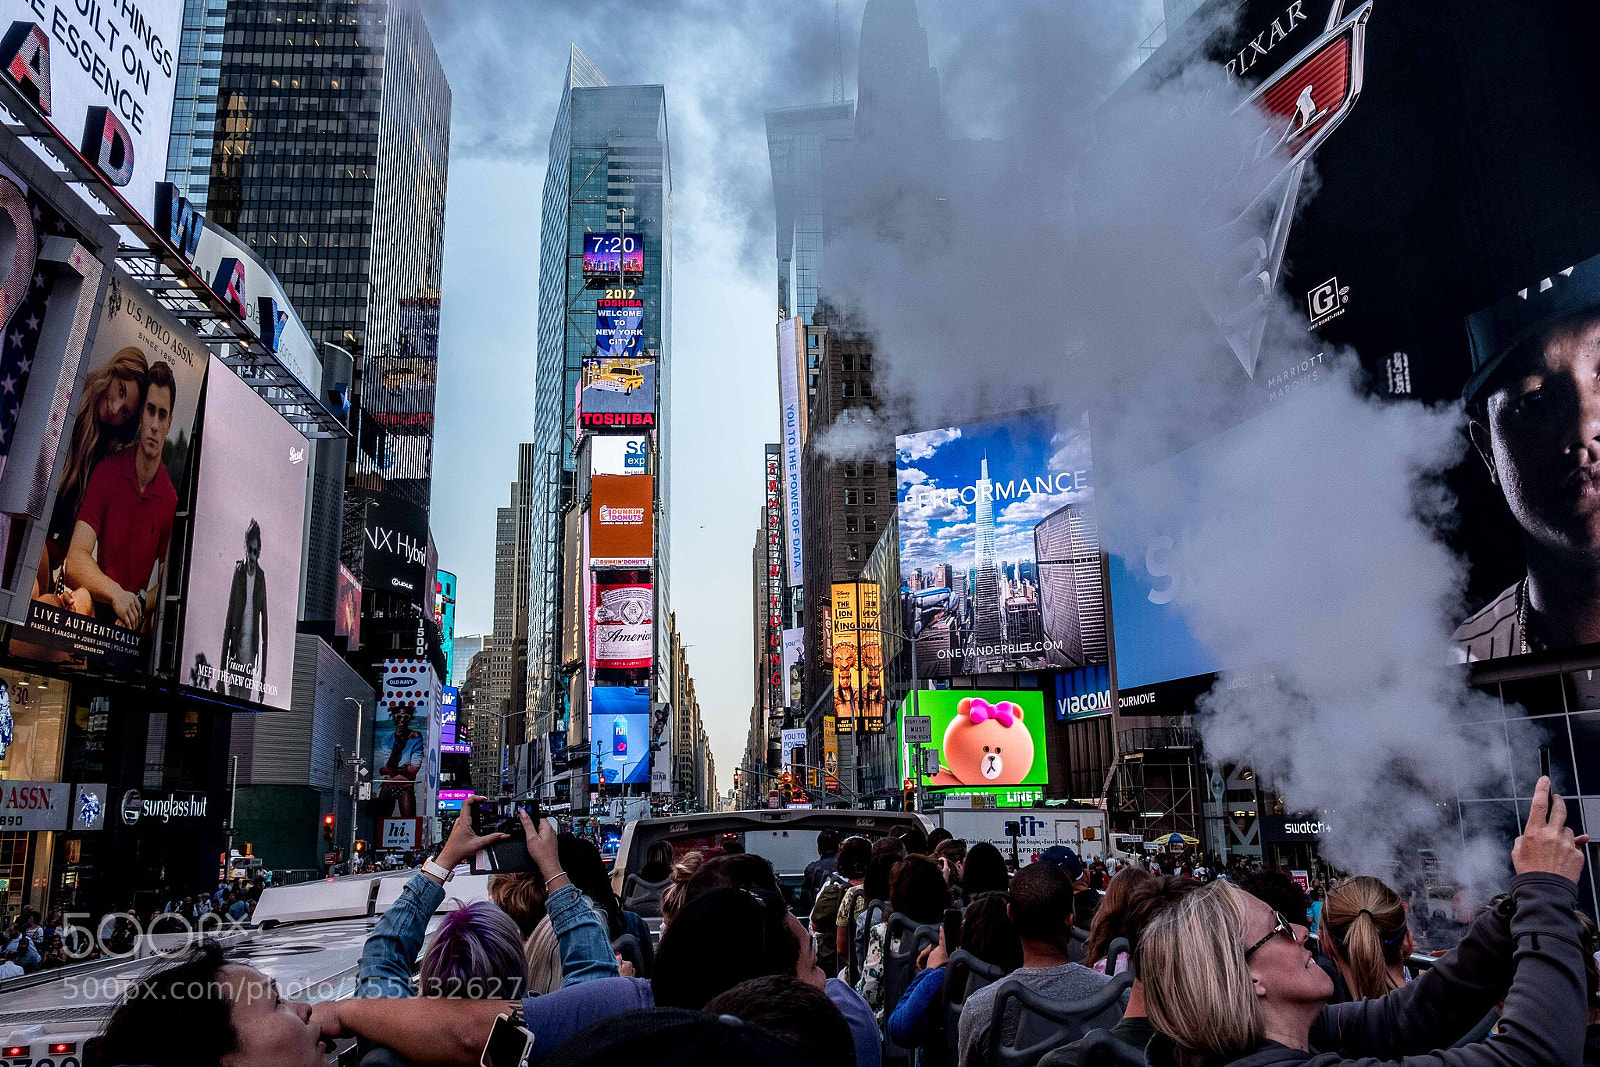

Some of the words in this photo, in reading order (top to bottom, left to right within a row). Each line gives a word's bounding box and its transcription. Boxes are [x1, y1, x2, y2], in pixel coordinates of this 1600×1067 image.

[114, 0, 173, 78] HINGS
[1223, 0, 1308, 88] PIXAR
[52, 5, 144, 136] ESSENCE
[122, 44, 150, 96] ON
[592, 236, 635, 253] 7:20
[605, 289, 636, 300] 2017
[126, 298, 144, 325] U.S.
[145, 315, 171, 345] POLO
[170, 338, 195, 368] ASSN.
[138, 331, 159, 352] SINCE
[1268, 352, 1324, 389] MARRIOTT
[582, 413, 654, 425] TOSHIBA
[786, 403, 796, 430] YOU
[787, 431, 797, 445] TO
[788, 448, 798, 471] THE
[789, 473, 800, 517] POWER
[904, 470, 1088, 509] PERFORMANCE
[791, 519, 801, 536] OF
[397, 532, 427, 567] Hybrid
[792, 539, 802, 573] DATA.
[30, 621, 51, 633] PAMELA
[34, 606, 60, 624] LIVE
[65, 616, 141, 647] AUTHENTICALLY
[834, 620, 856, 633] KING
[835, 609, 853, 620] LION
[415, 618, 425, 656] 1500
[770, 594, 782, 686] YOUNG
[937, 639, 1064, 660] ONEVANDERBILT.COM
[197, 663, 216, 680] MEET
[216, 669, 230, 685] THE
[230, 673, 246, 689] NEW
[244, 677, 279, 697] GENERATION
[6, 786, 54, 811] ASSN.
[143, 793, 190, 823] sunglass
[190, 793, 208, 817] hut
[1006, 791, 1034, 803] LINE
[389, 822, 410, 838] hi.
[1284, 821, 1325, 835] swatch
